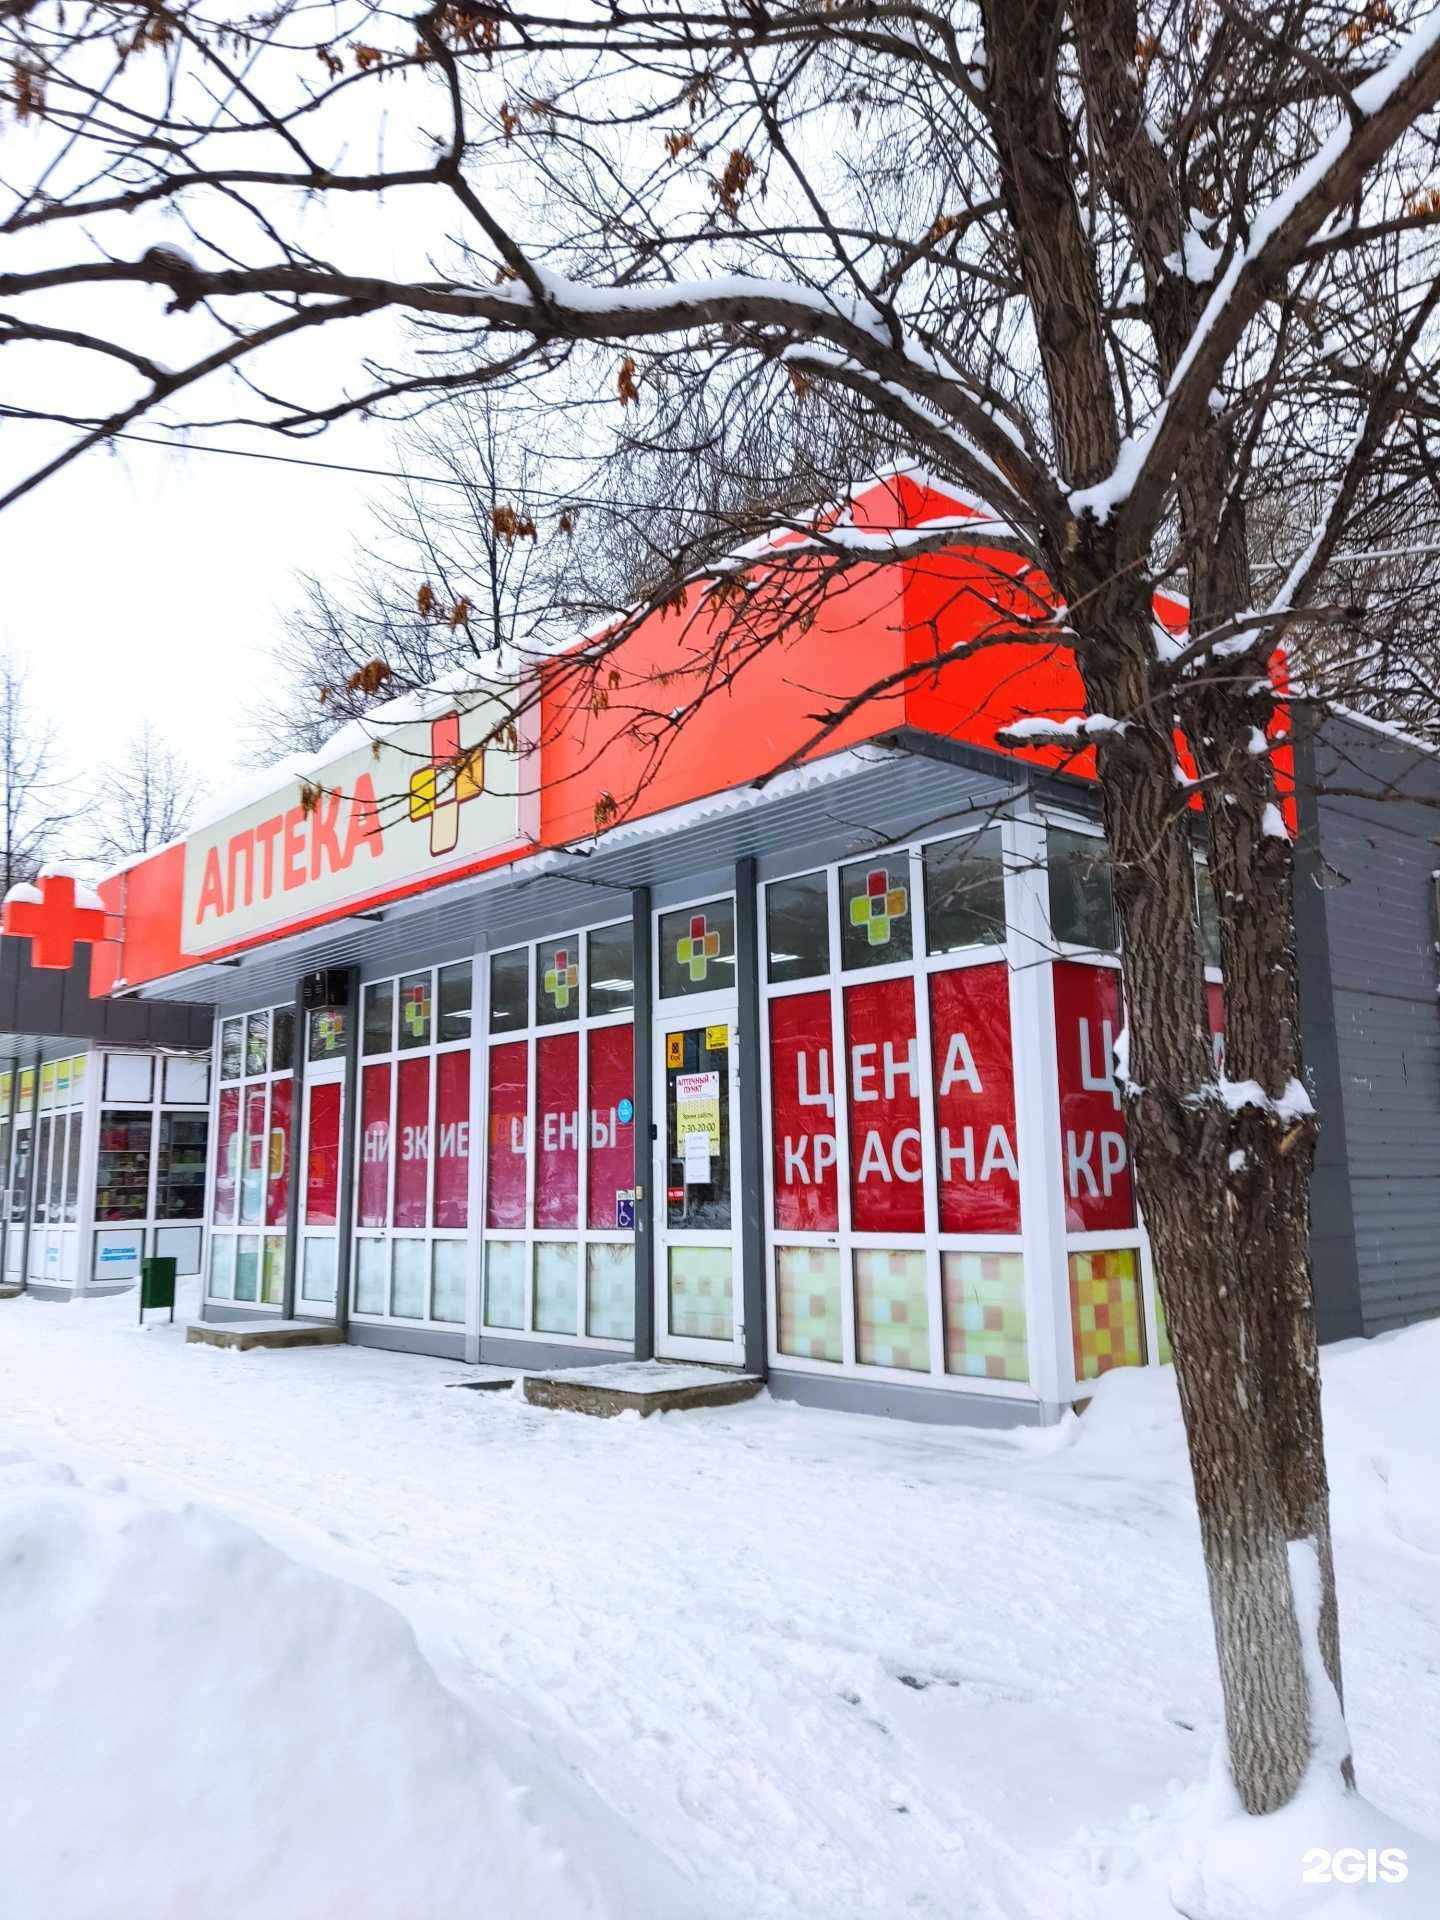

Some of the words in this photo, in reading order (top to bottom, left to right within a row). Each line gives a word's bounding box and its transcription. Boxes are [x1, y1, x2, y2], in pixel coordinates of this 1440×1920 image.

[196, 772, 384, 925] АПТЕКА
[678, 1075, 709, 1087] АПТЕЧНЫЙ
[683, 1085, 703, 1094] ПУНКТ
[797, 1032, 983, 1118] ЦЕНА
[1079, 1016, 1122, 1112] Ц
[363, 1121, 469, 1163] НИЗКИЕ
[511, 1107, 617, 1154] ЦЕНЫ
[784, 1124, 1020, 1185] КРАСНА
[1066, 1130, 1127, 1198] КР
